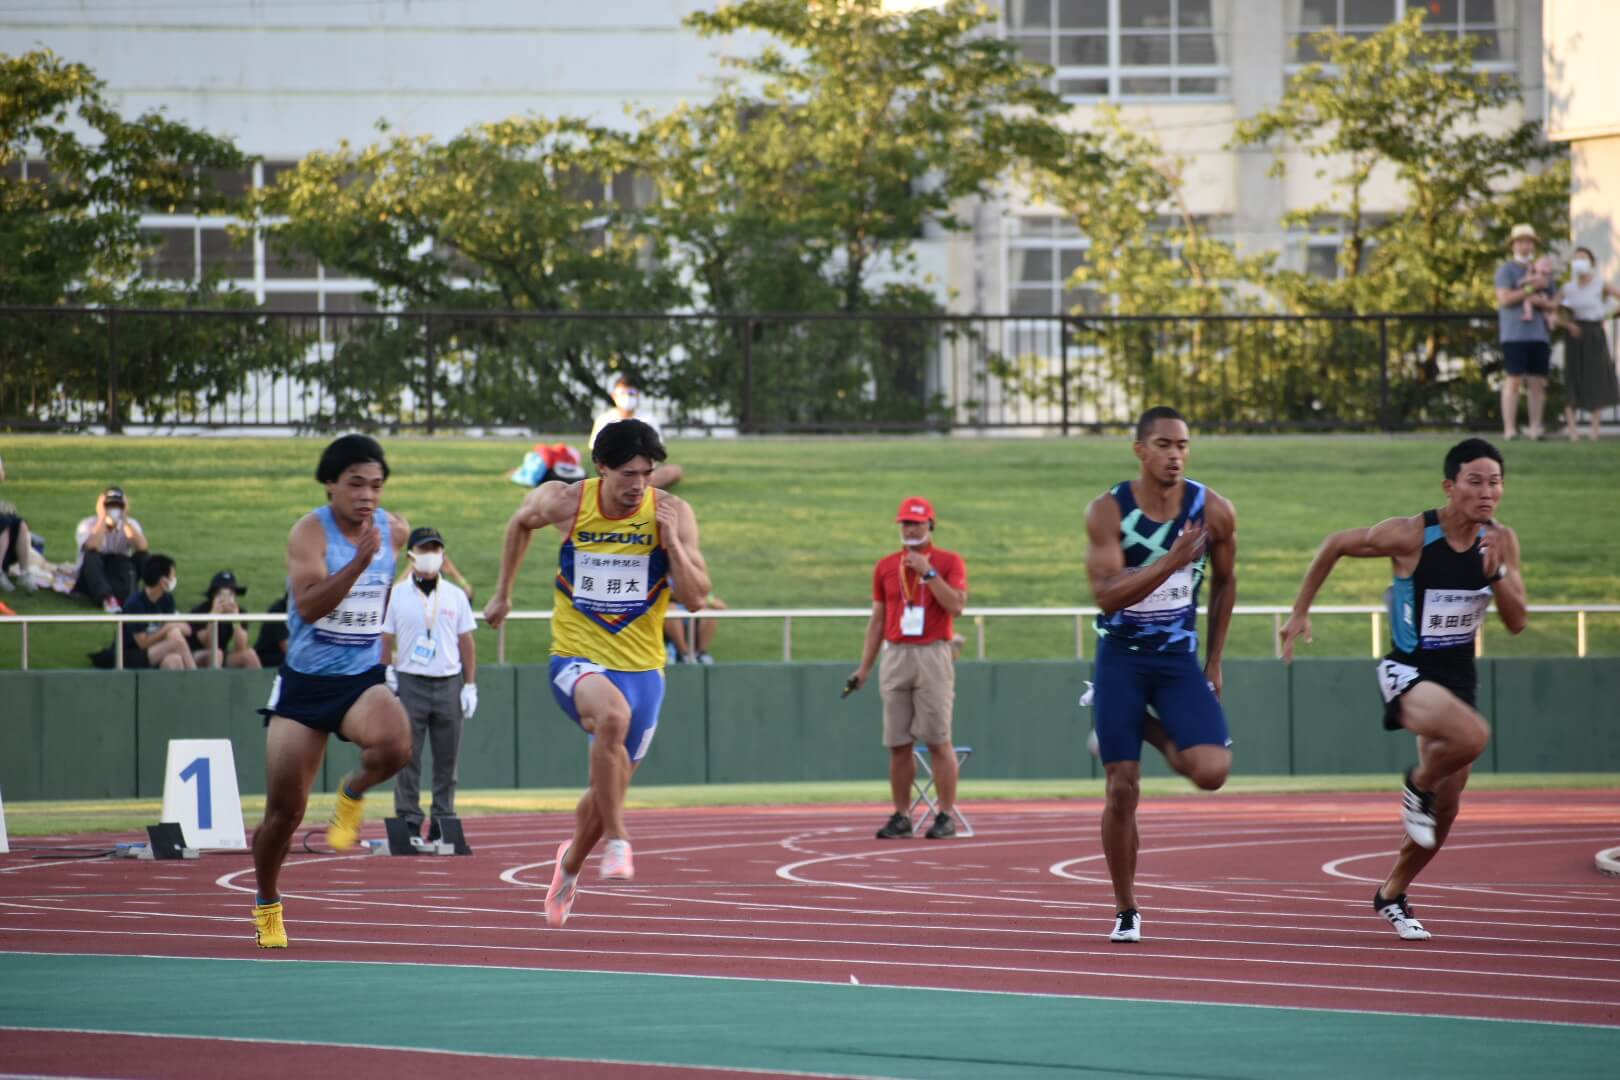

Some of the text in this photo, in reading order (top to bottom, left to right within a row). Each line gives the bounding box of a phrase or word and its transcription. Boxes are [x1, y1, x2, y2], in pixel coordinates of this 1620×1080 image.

[577, 531, 653, 545] SUZUKI
[581, 576, 640, 594] 原 翔太
[179, 757, 212, 830] 1
